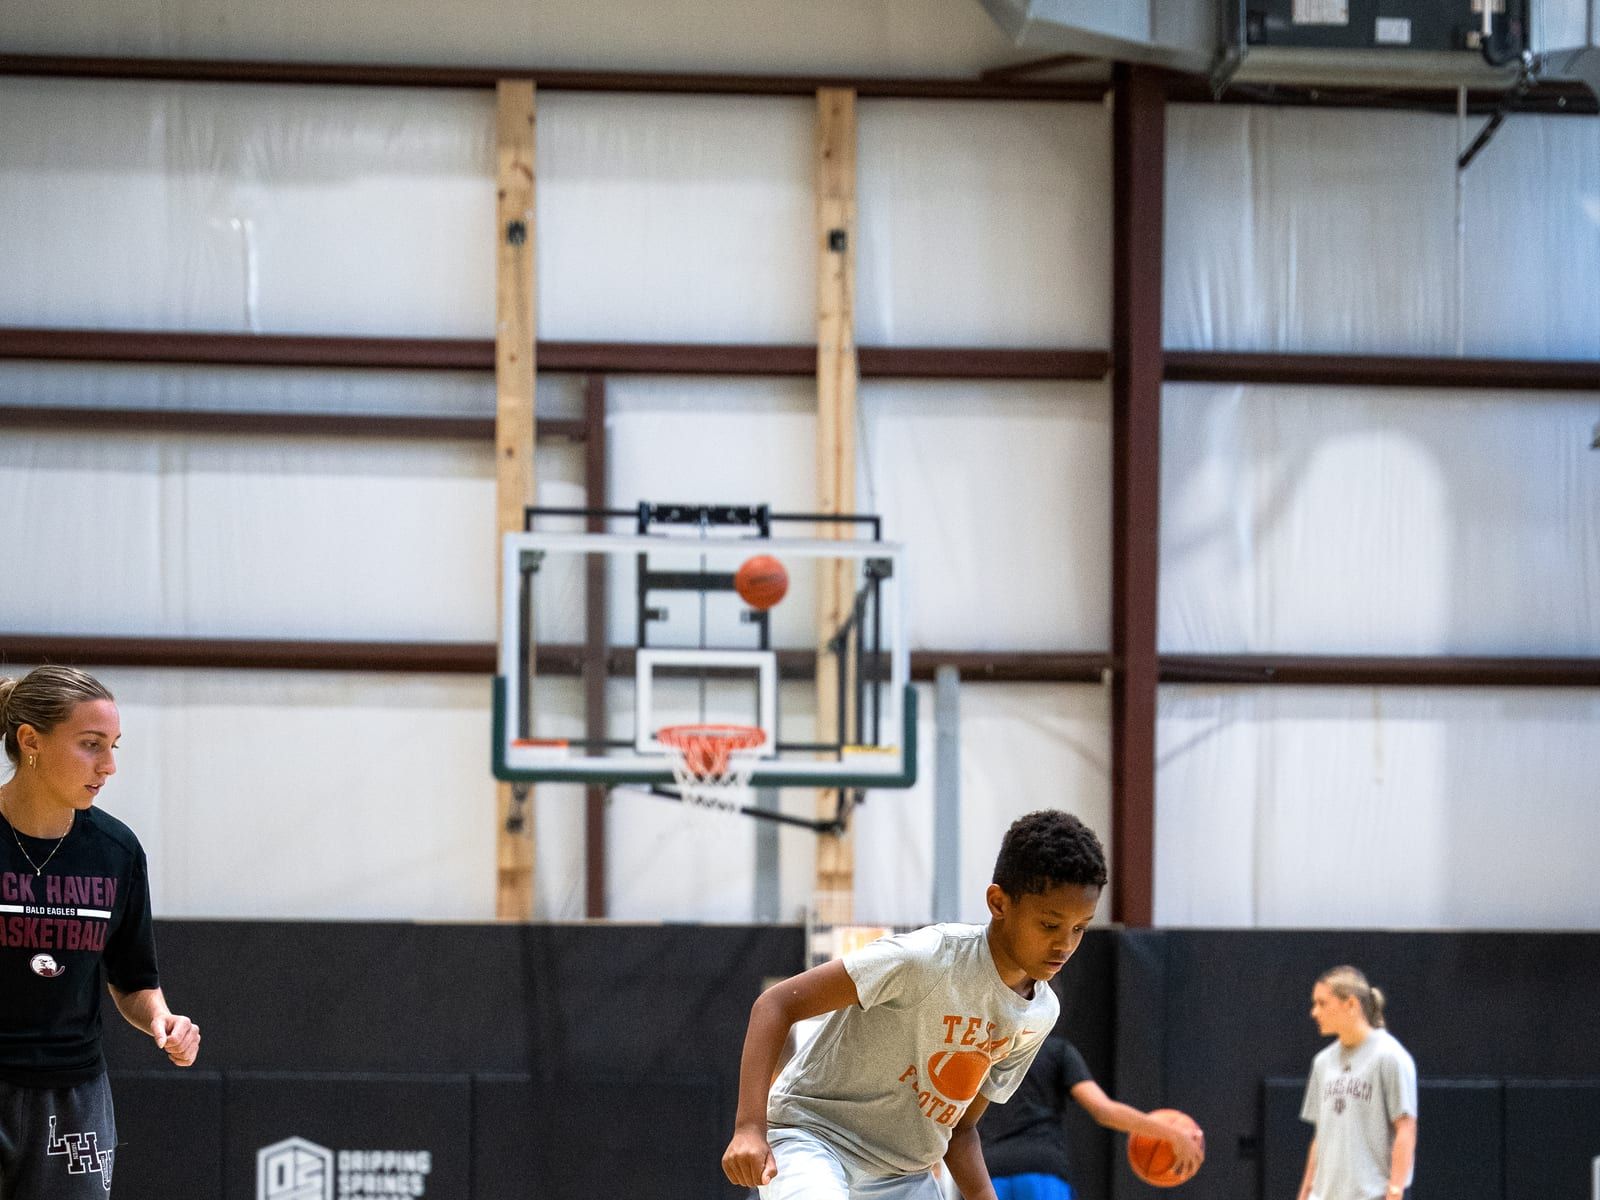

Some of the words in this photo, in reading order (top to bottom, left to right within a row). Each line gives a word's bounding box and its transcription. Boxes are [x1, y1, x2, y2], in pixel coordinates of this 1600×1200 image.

[0, 872, 36, 903] CK
[46, 874, 118, 907] HAVEN
[25, 906, 45, 915] BALD
[46, 907, 76, 916] EAGLES
[338, 1173, 425, 1197] SPRINGS
